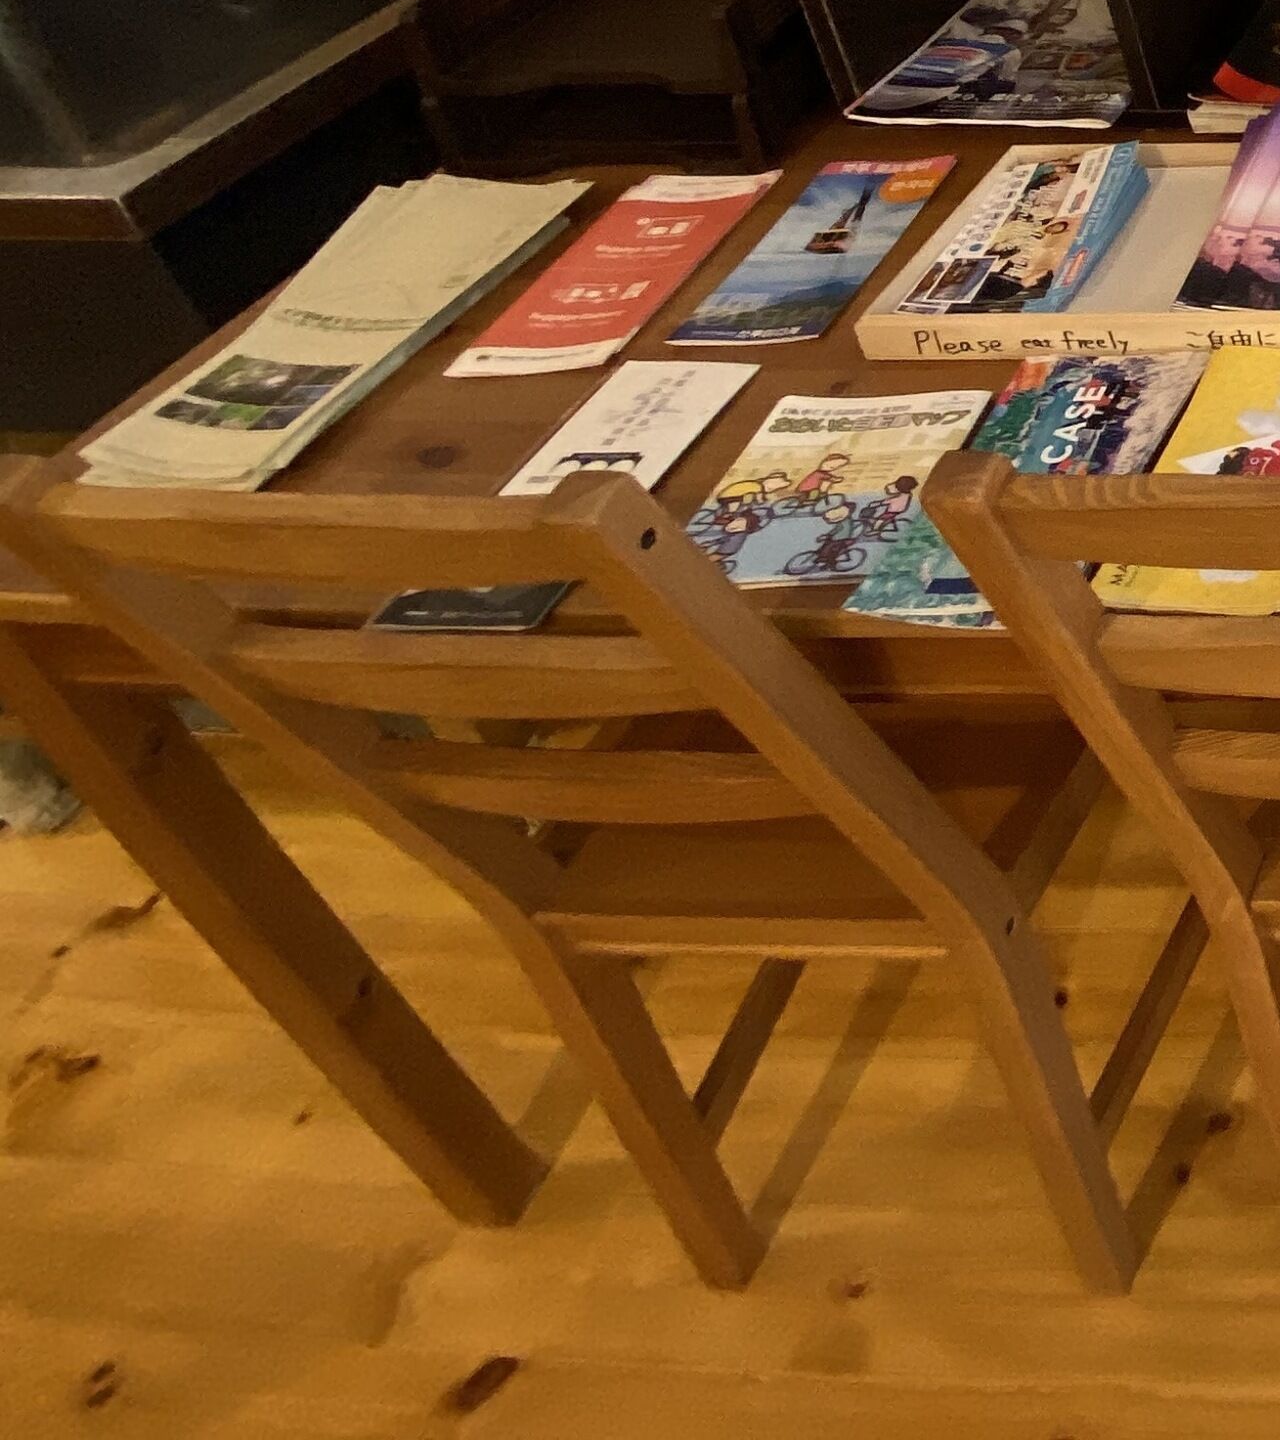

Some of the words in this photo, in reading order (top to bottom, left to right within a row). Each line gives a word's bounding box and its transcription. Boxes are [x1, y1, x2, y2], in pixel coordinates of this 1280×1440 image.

[914, 329, 1003, 355] Please
[1054, 330, 1130, 355] freely
[1186, 328, 1277, 350] ご自由に
